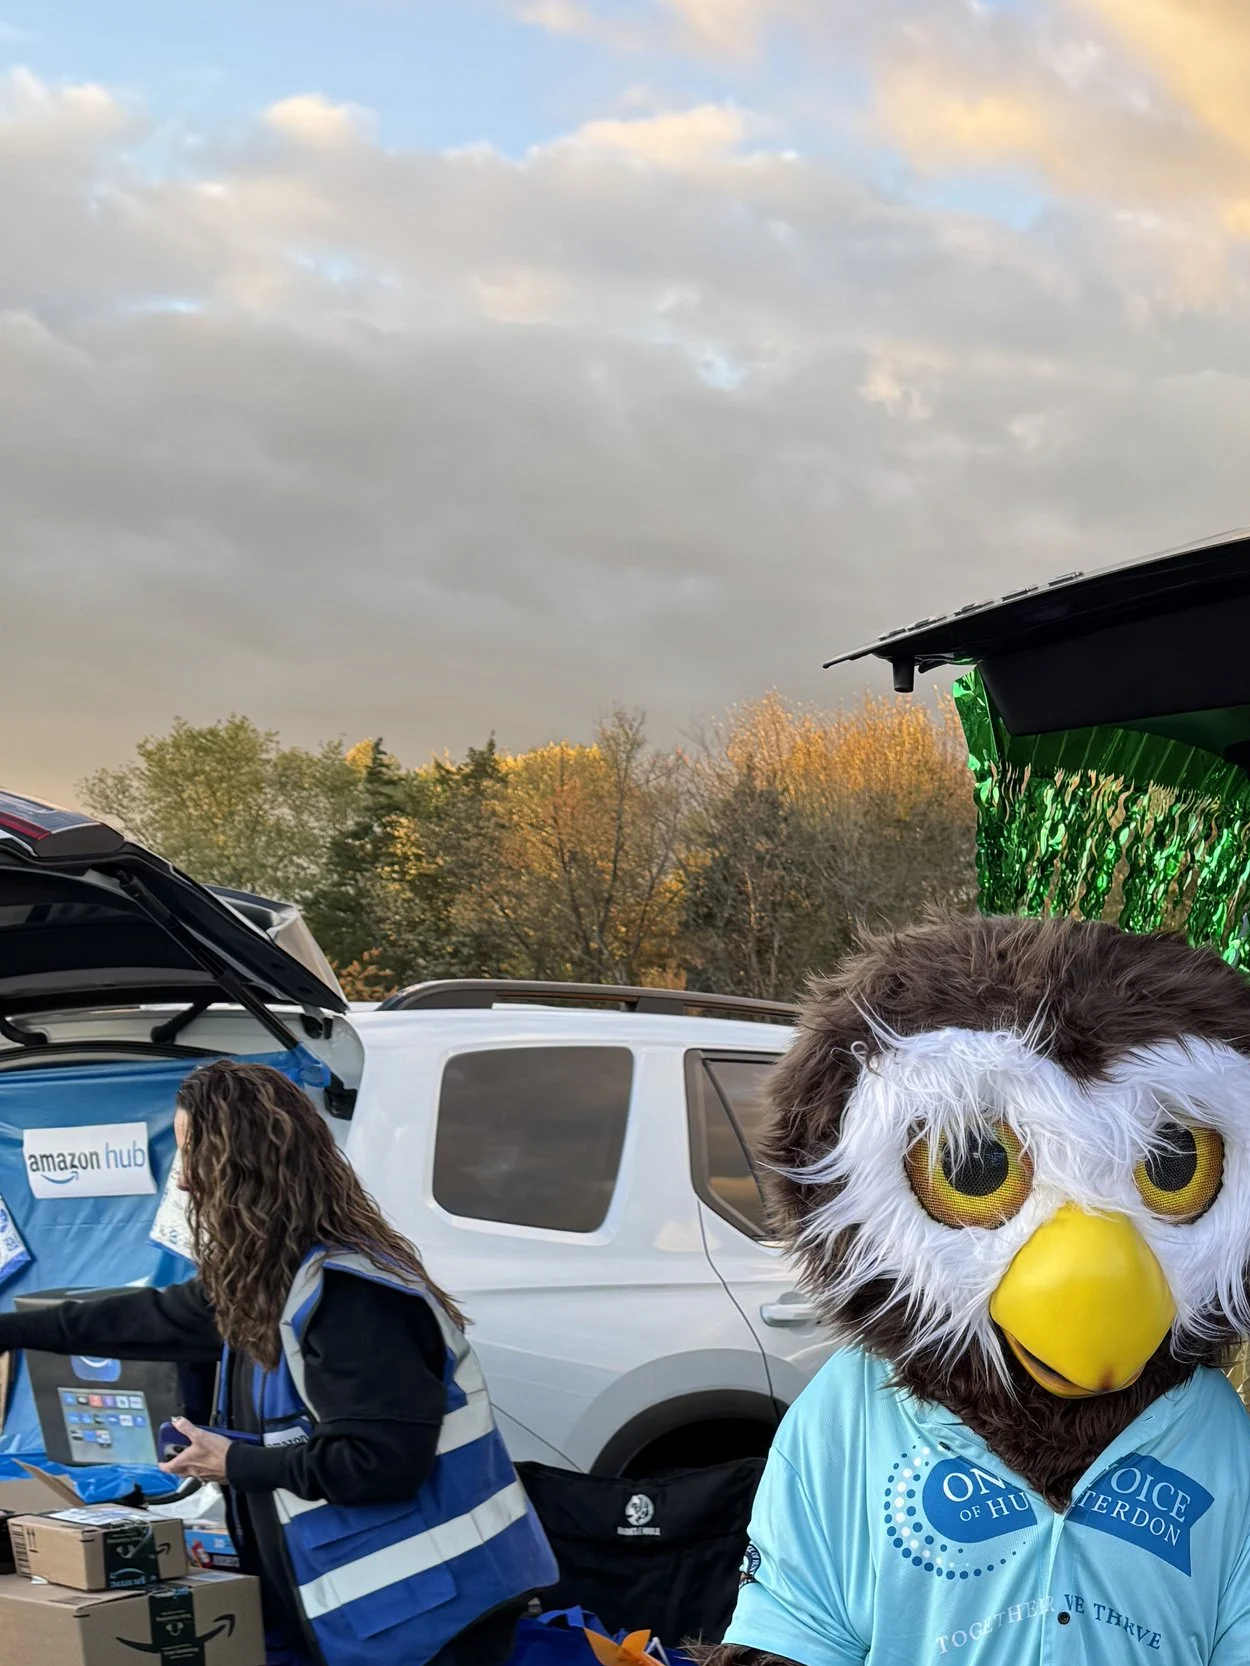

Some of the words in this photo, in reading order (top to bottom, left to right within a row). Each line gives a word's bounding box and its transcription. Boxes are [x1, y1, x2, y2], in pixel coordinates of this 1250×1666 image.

[28, 1150, 101, 1173] amazon
[105, 1140, 146, 1169] hub
[943, 1467, 1007, 1502] ON
[1110, 1466, 1191, 1523] OICE
[959, 1505, 981, 1522] OF
[936, 1595, 1056, 1655] TOGETHER
